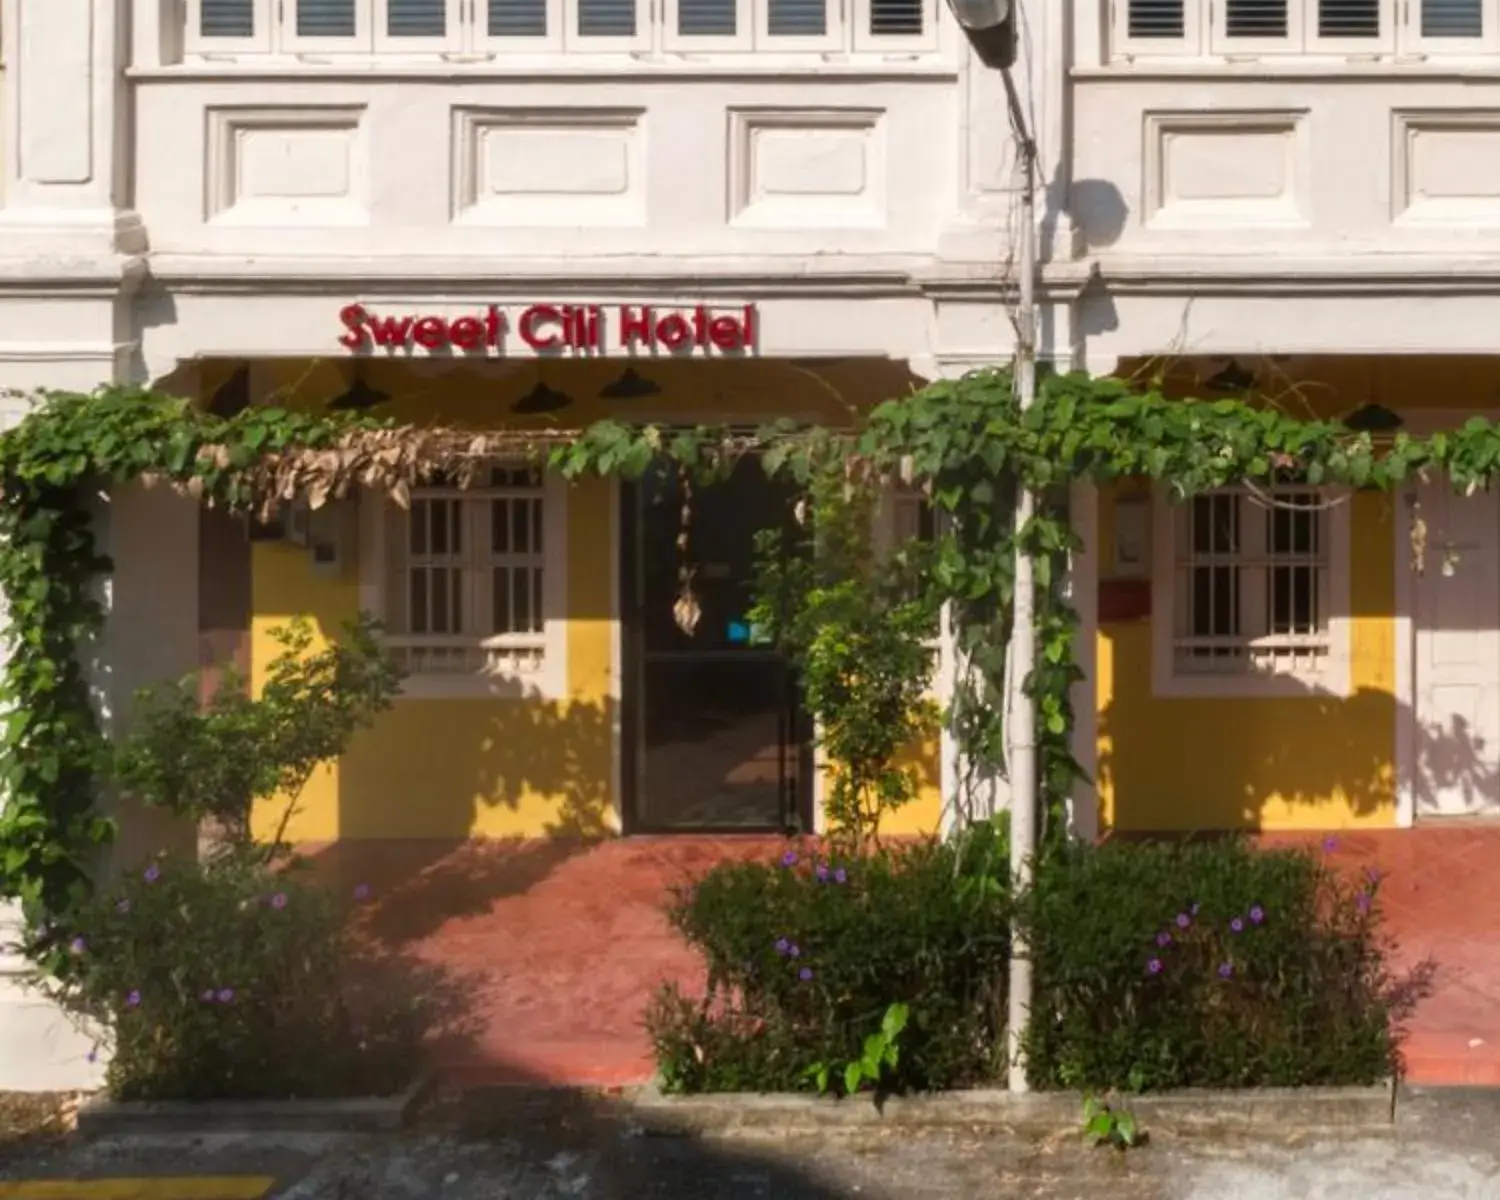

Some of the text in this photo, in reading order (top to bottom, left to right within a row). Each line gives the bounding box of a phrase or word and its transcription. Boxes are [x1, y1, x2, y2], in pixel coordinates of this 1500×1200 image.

[338, 303, 755, 349] Sweet Cili Hotel
